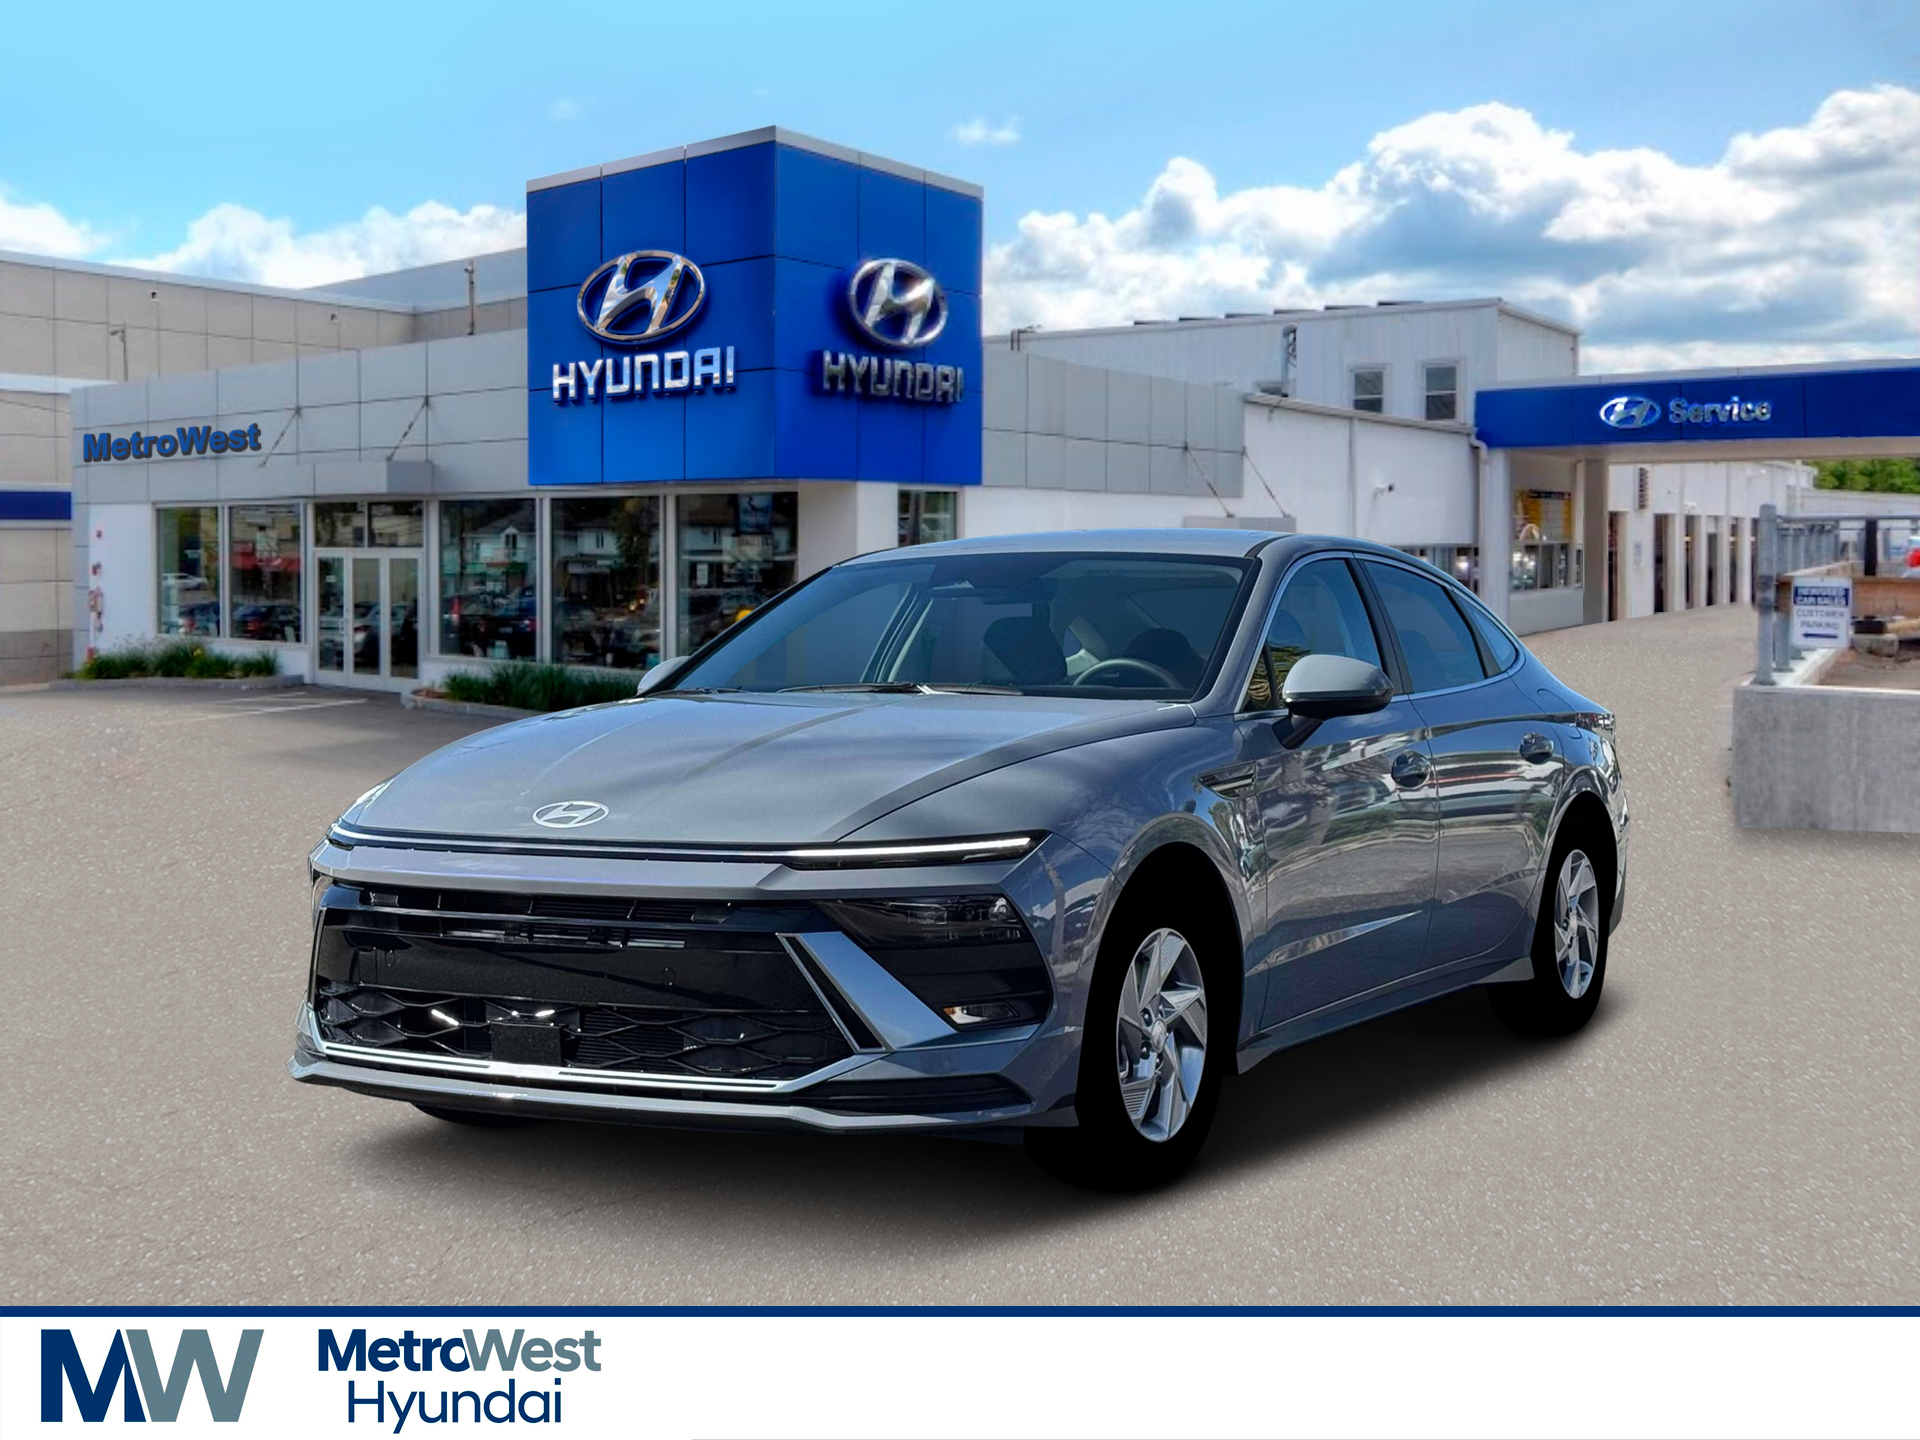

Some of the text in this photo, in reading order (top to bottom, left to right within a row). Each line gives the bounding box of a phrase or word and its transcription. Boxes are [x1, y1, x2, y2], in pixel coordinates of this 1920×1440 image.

[552, 345, 735, 402] HYUNDAI
[822, 349, 963, 403] HYUNDAI
[1669, 396, 1772, 424] Service
[83, 423, 262, 463] MetroWest
